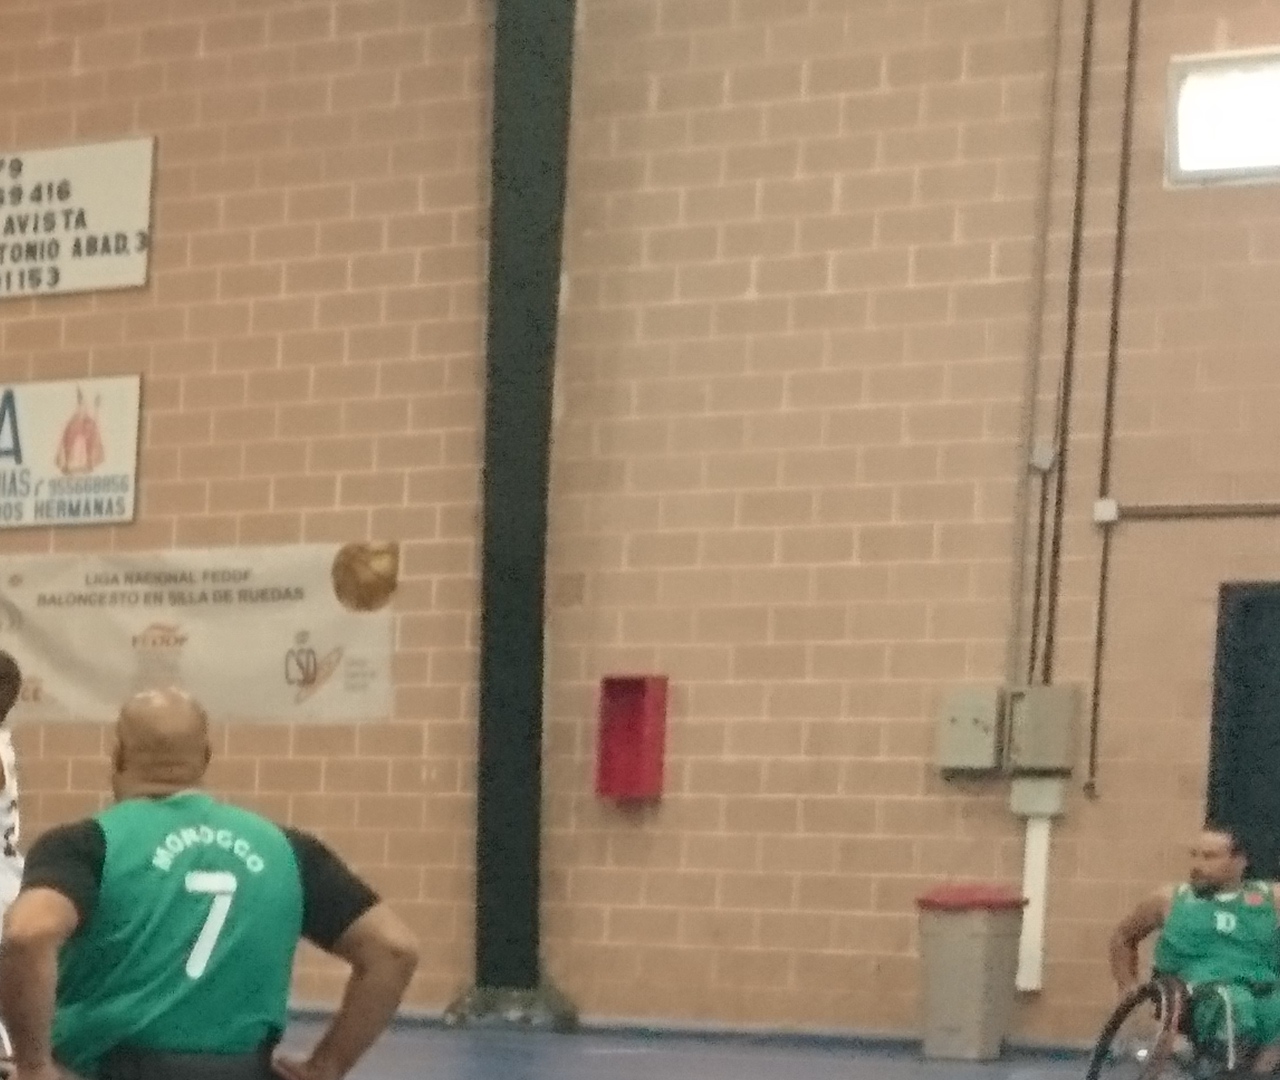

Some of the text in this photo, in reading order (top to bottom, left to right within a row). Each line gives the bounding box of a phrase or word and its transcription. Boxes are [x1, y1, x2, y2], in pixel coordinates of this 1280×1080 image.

[33, 496, 127, 521] HERMANAS
[124, 570, 195, 586] NACIONAL
[37, 591, 139, 608] BALONCESTO
[142, 589, 164, 606] EN
[212, 588, 234, 605] DE
[236, 585, 305, 604] RUEDAS
[152, 825, 265, 873] MOROCCO
[184, 870, 238, 980] 7
